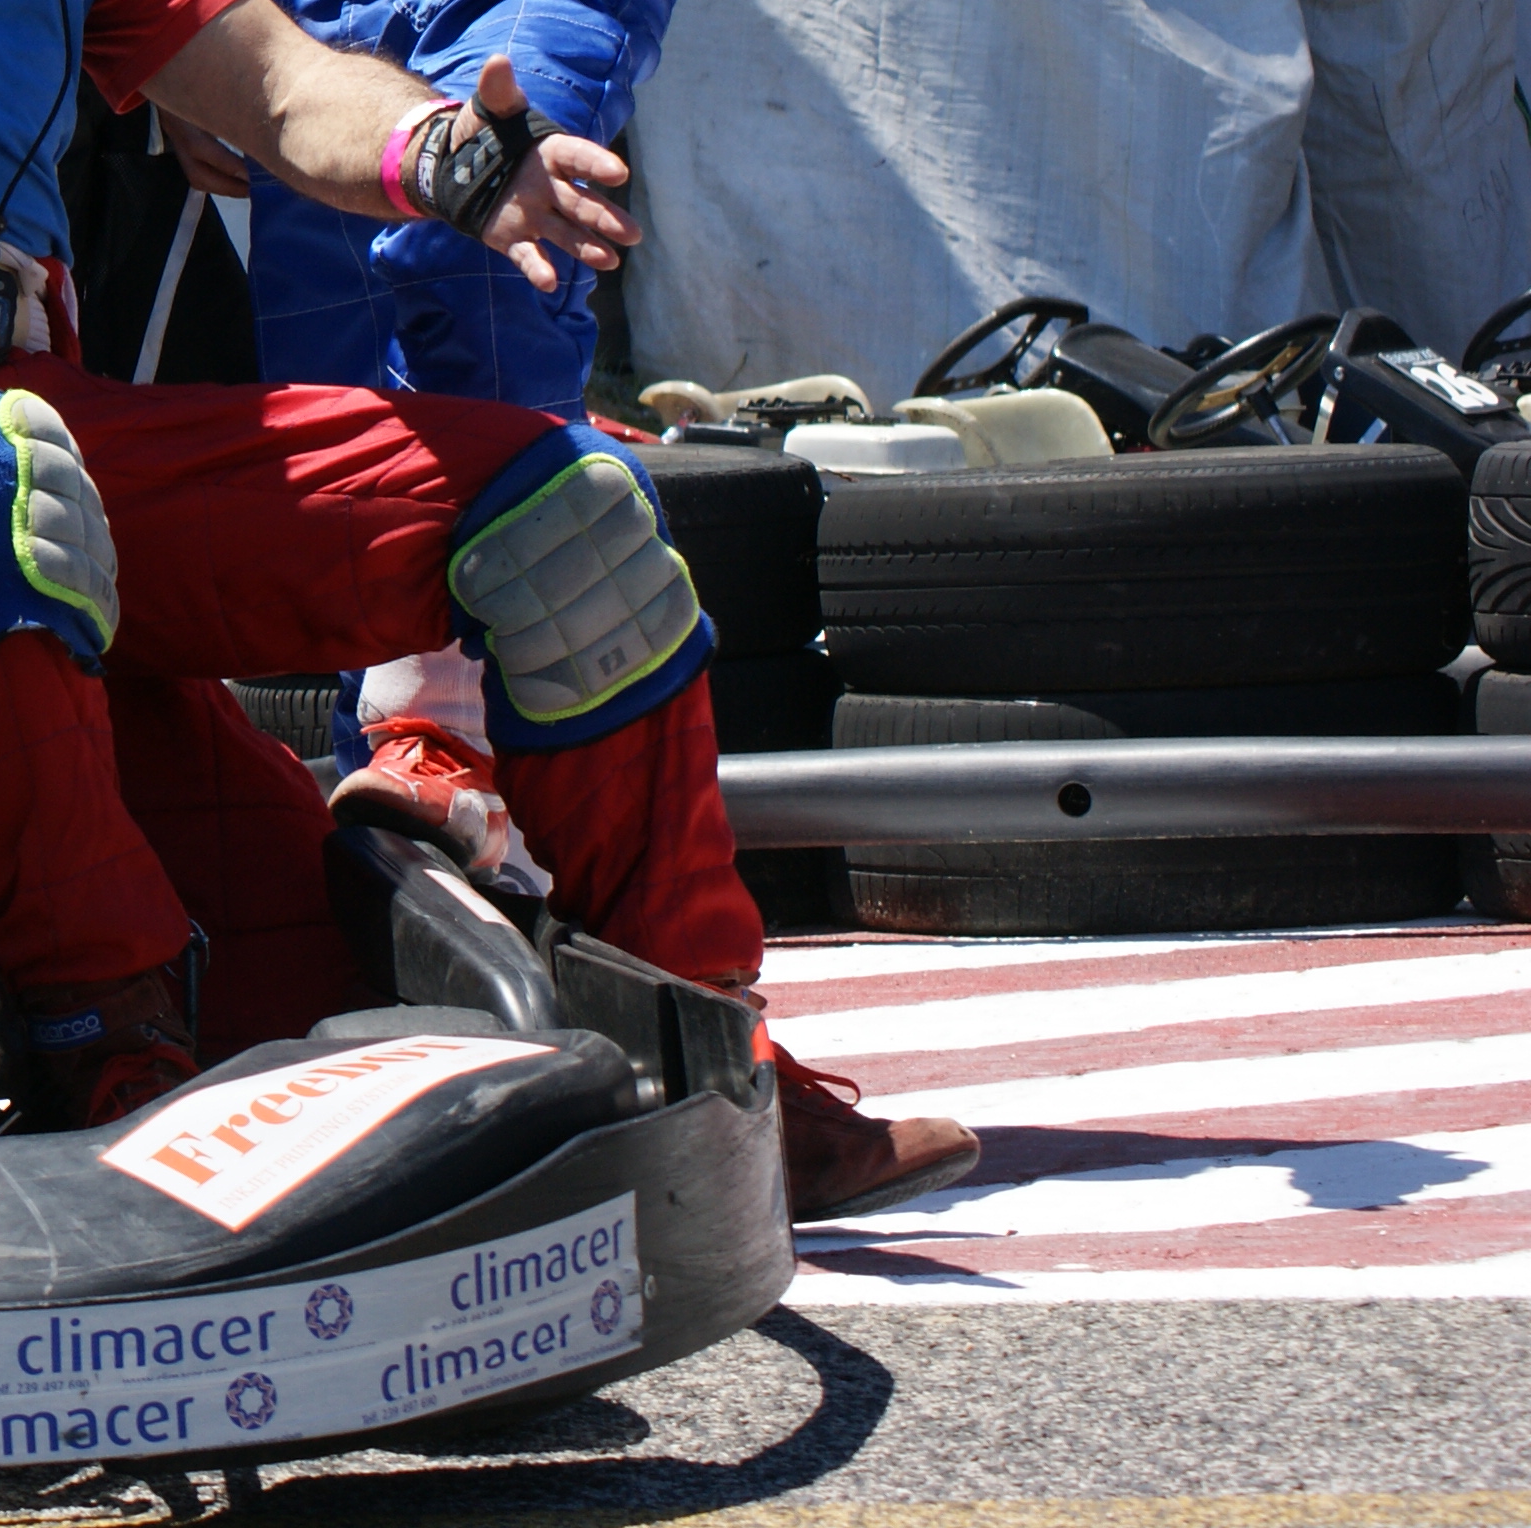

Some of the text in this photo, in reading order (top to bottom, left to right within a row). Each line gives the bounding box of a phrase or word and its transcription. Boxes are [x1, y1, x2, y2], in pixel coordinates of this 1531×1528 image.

[1410, 362, 1499, 408] 26
[145, 1040, 469, 1189] FreeDOT
[273, 1112, 351, 1170] PRINTING
[450, 1218, 624, 1312] climacer
[17, 1310, 276, 1376] climacer
[380, 1313, 572, 1403] climacer
[17, 1382, 38, 1394] 239
[42, 1380, 65, 1392] 497
